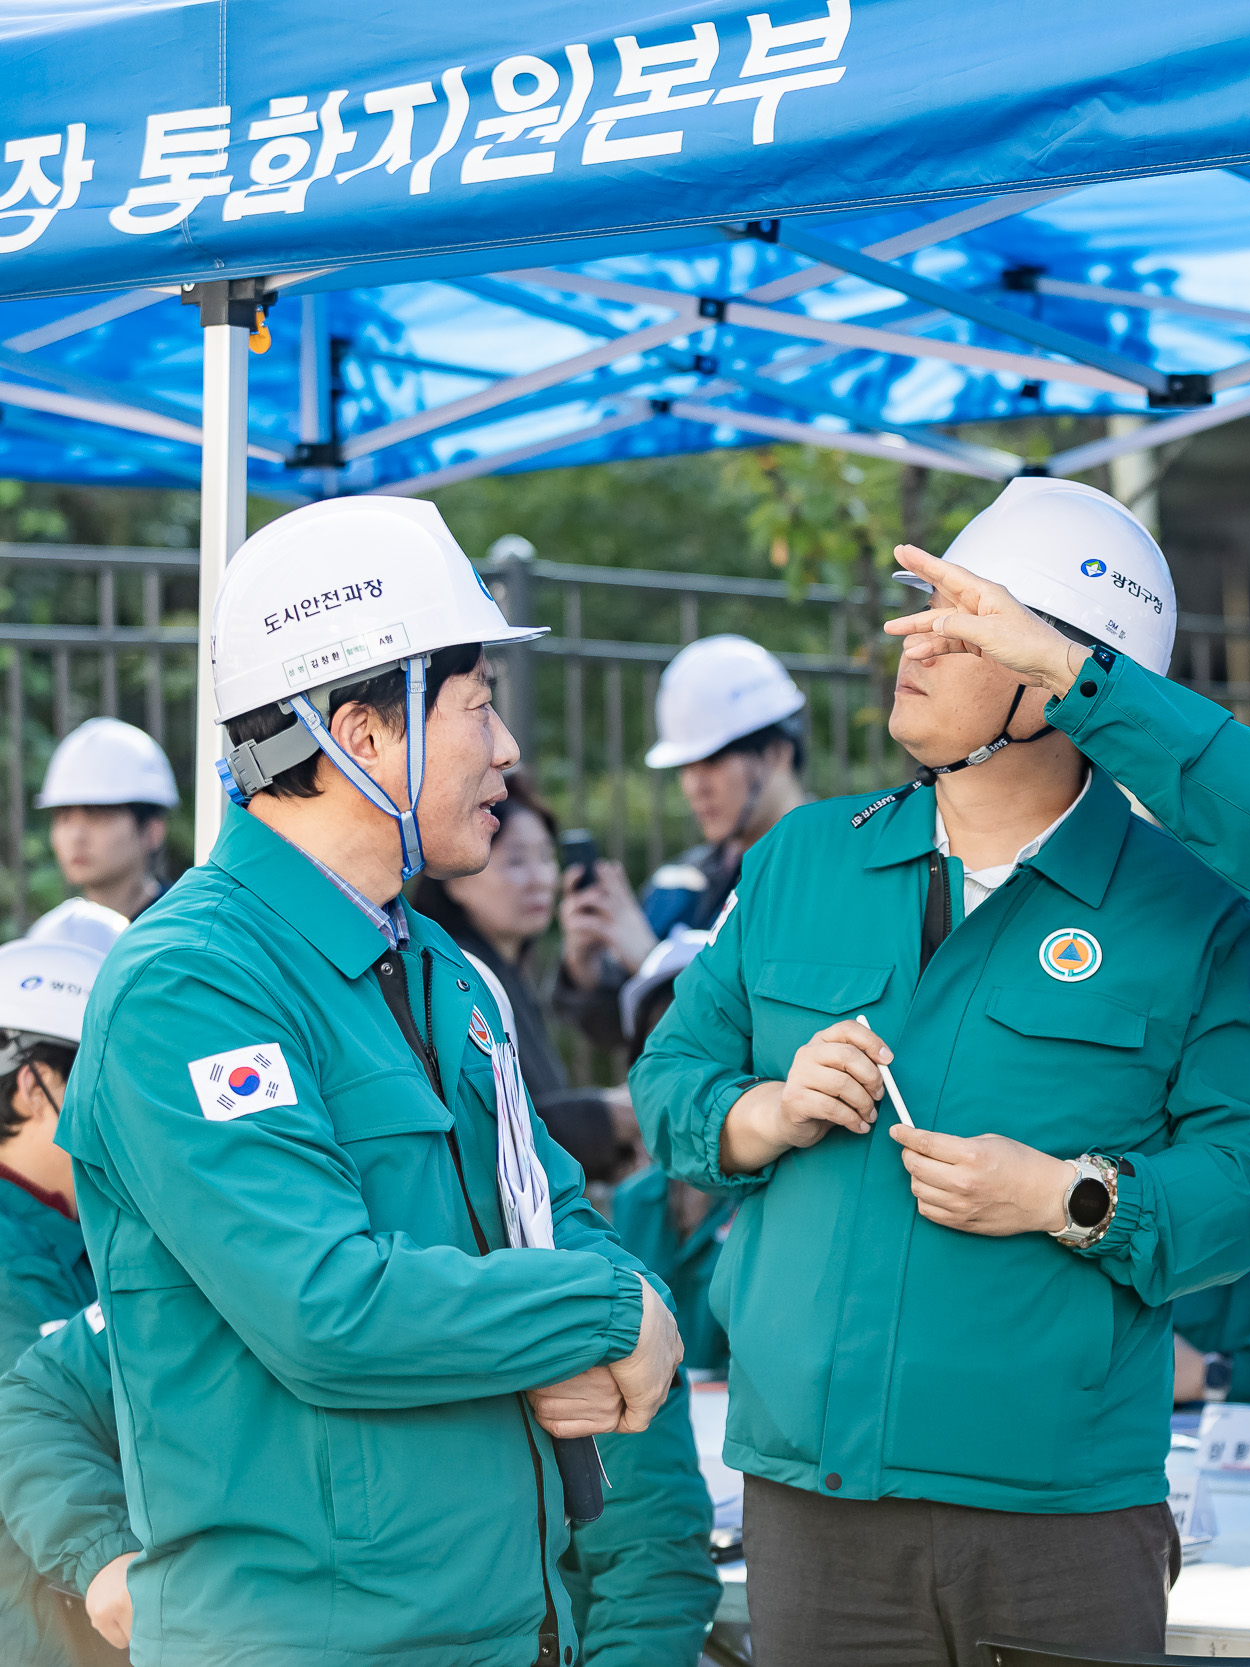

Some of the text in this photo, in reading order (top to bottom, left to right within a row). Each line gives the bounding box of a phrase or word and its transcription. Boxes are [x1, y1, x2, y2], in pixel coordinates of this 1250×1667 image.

[108, 0, 851, 235] 통합지원본부
[264, 578, 383, 635] 도시안전과장
[1110, 570, 1163, 614] 광진구청
[379, 634, 393, 646] A형
